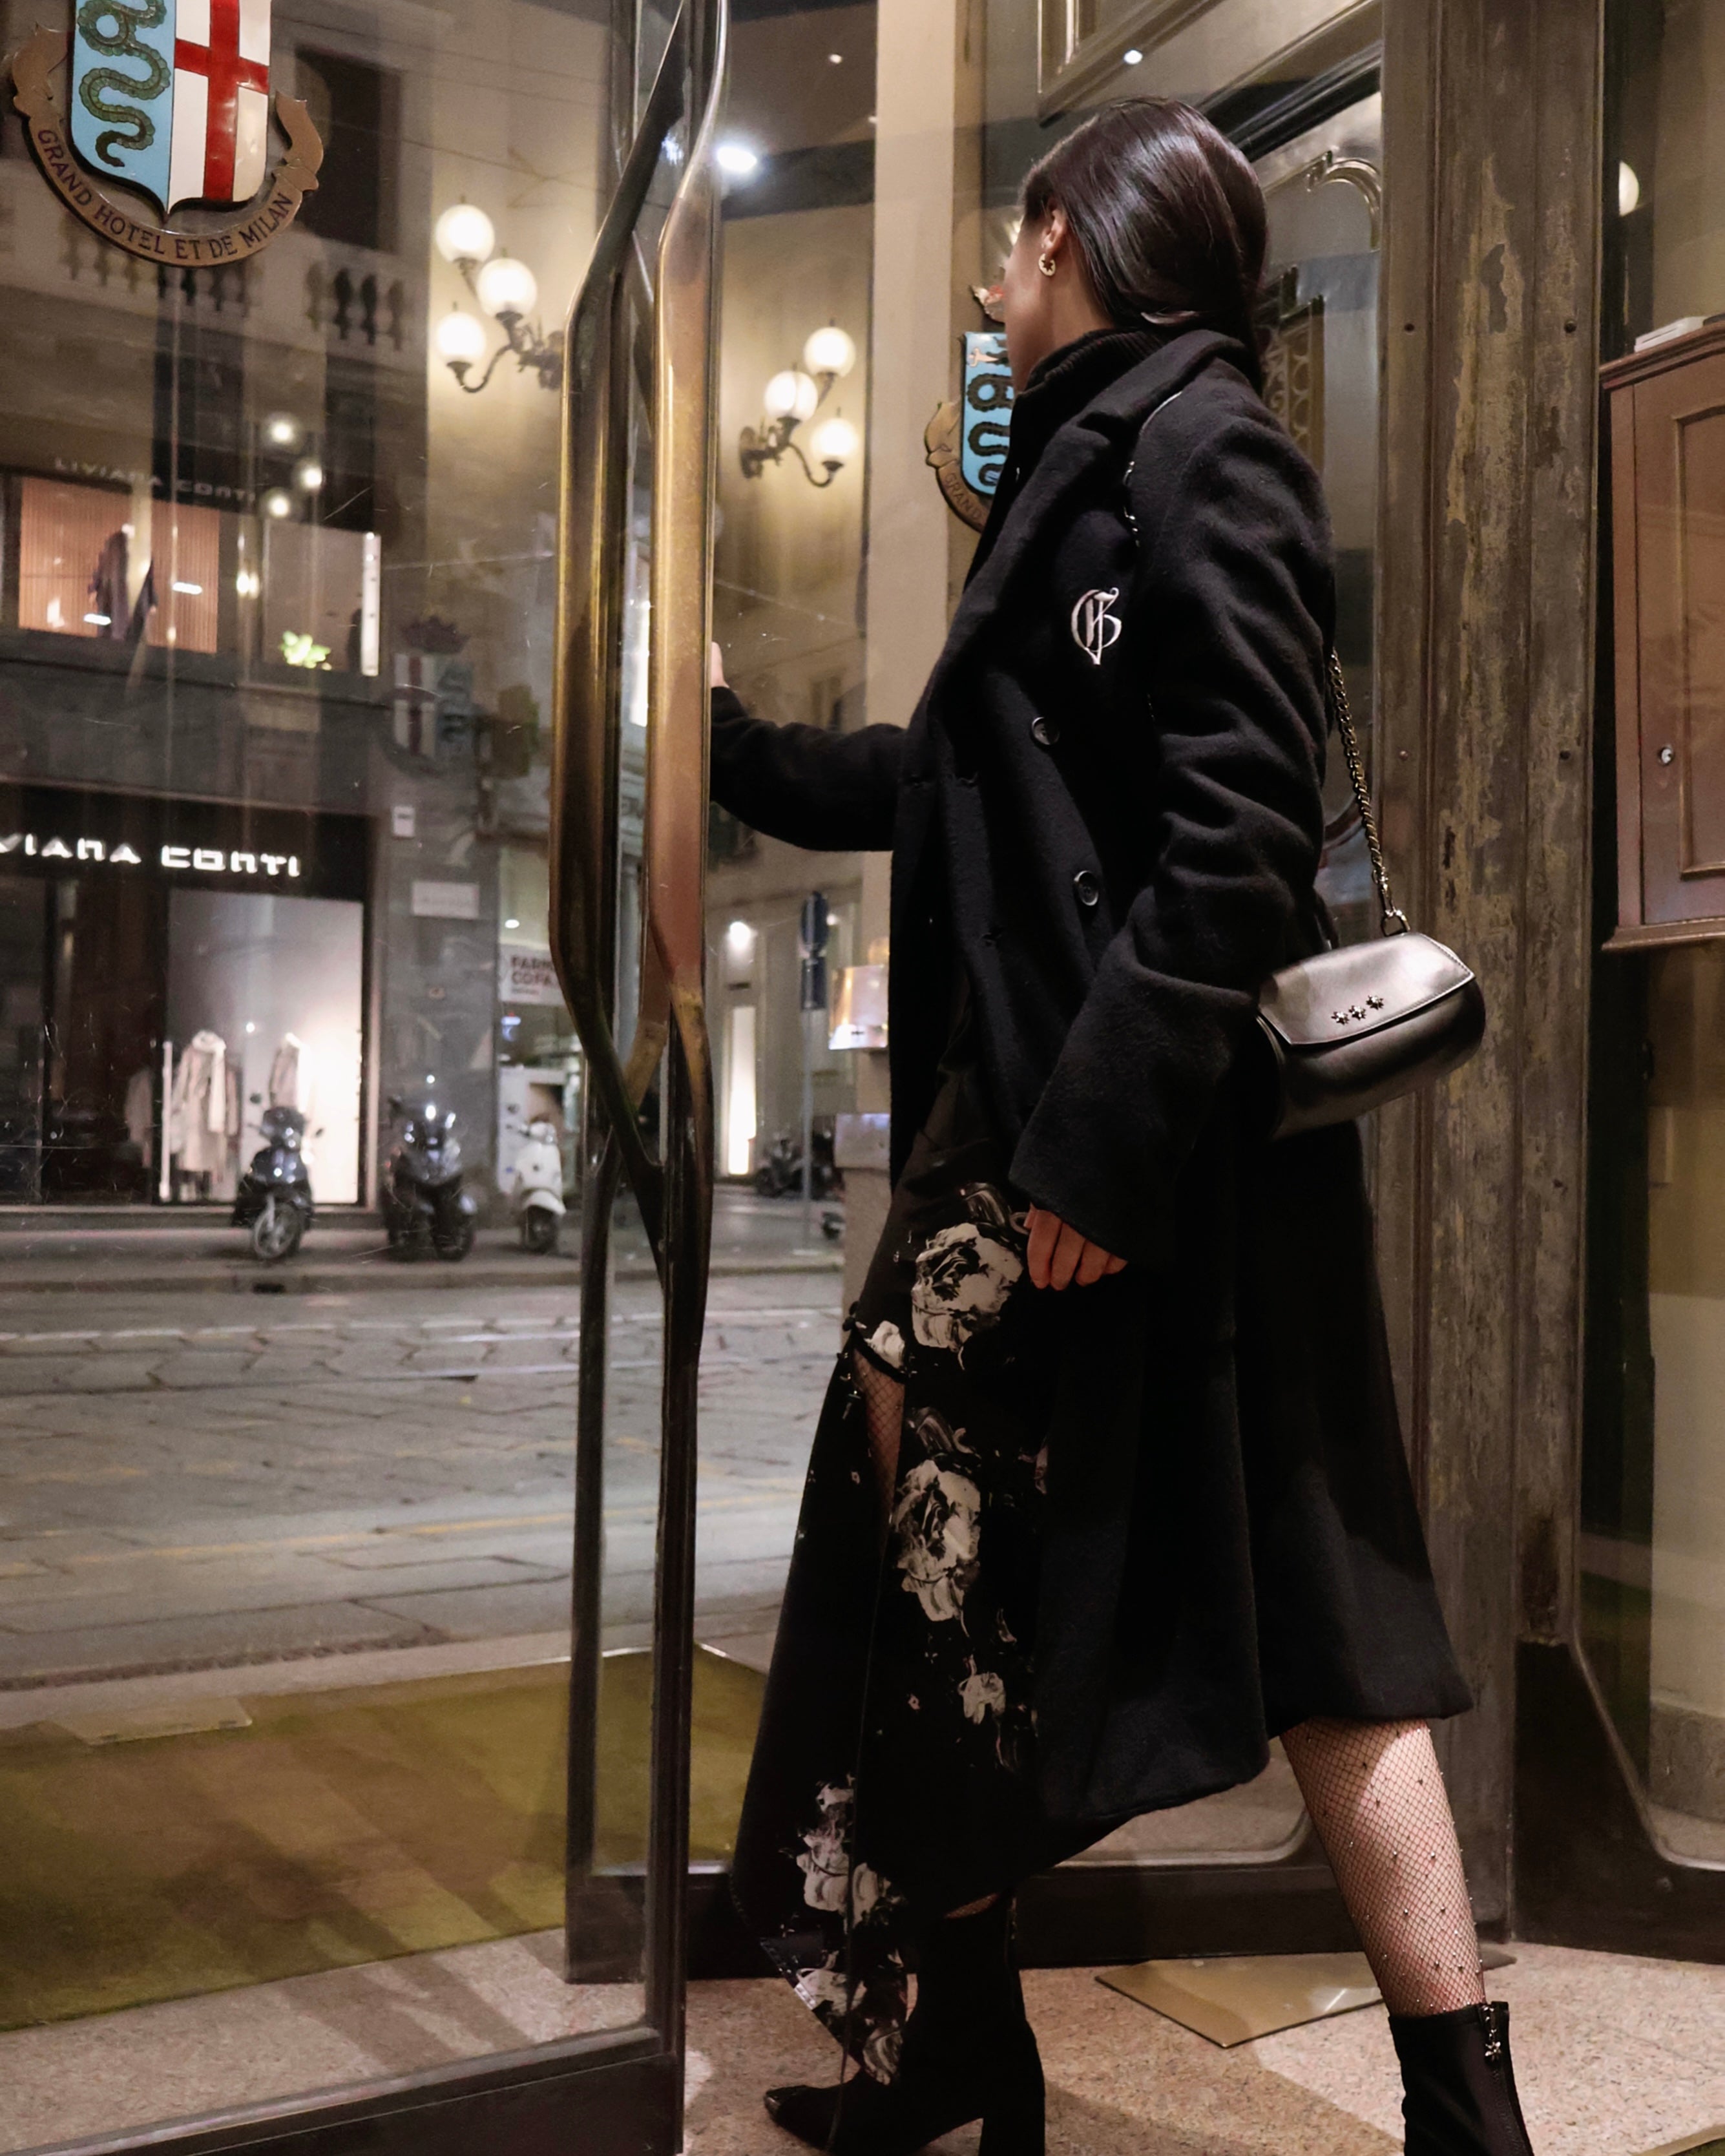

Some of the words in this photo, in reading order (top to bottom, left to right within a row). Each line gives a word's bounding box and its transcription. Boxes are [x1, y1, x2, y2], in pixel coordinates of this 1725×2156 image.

[38, 129, 92, 205] GRAND
[93, 204, 165, 255] HOTEL
[174, 238, 201, 260] ET
[207, 235, 238, 258] DE
[238, 193, 293, 248] MILAN
[161, 844, 302, 877] CONTI
